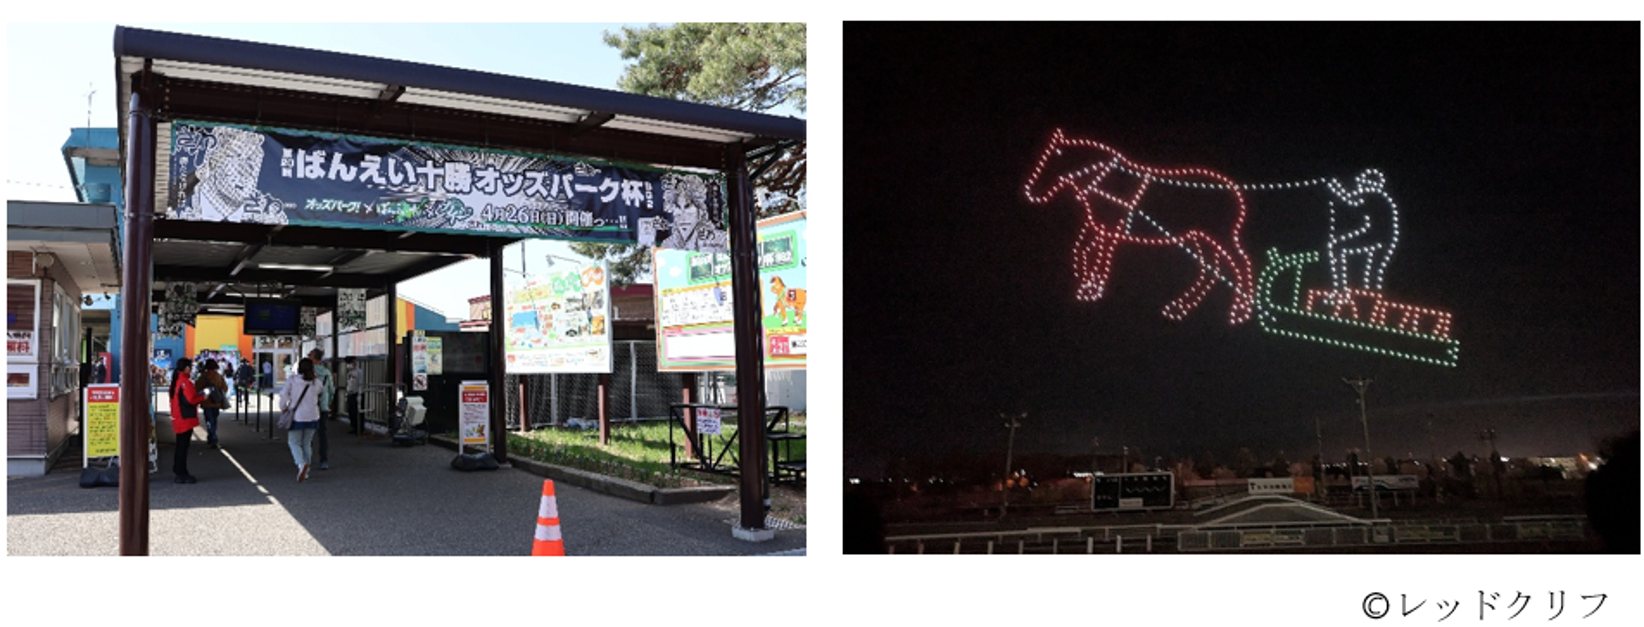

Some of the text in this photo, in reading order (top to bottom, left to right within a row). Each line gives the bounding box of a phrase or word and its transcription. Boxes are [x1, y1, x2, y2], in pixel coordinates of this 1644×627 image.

[296, 148, 645, 208] ばんえい十勝オッズパーク杯
